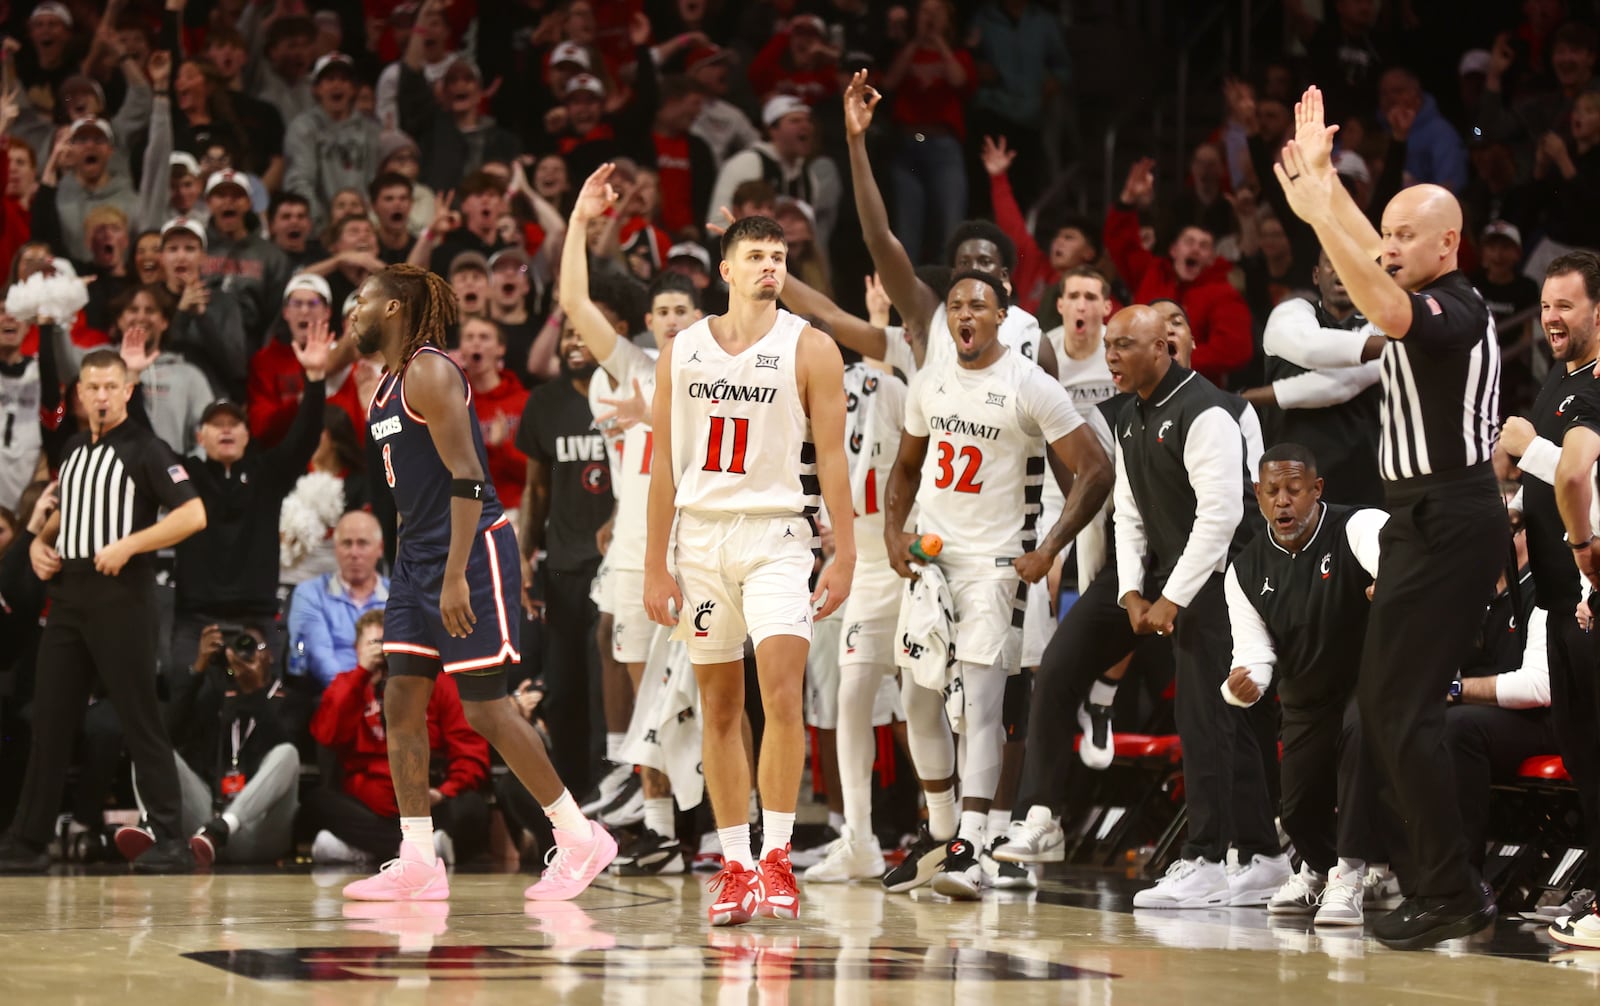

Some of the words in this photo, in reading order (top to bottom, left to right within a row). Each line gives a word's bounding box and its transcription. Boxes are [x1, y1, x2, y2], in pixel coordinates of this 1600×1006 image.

[689, 380, 778, 404] CINCINNATI
[930, 415, 1001, 441] CINCINNATI
[556, 435, 605, 463] LIVE
[702, 415, 750, 475] 11
[935, 441, 984, 494] 32
